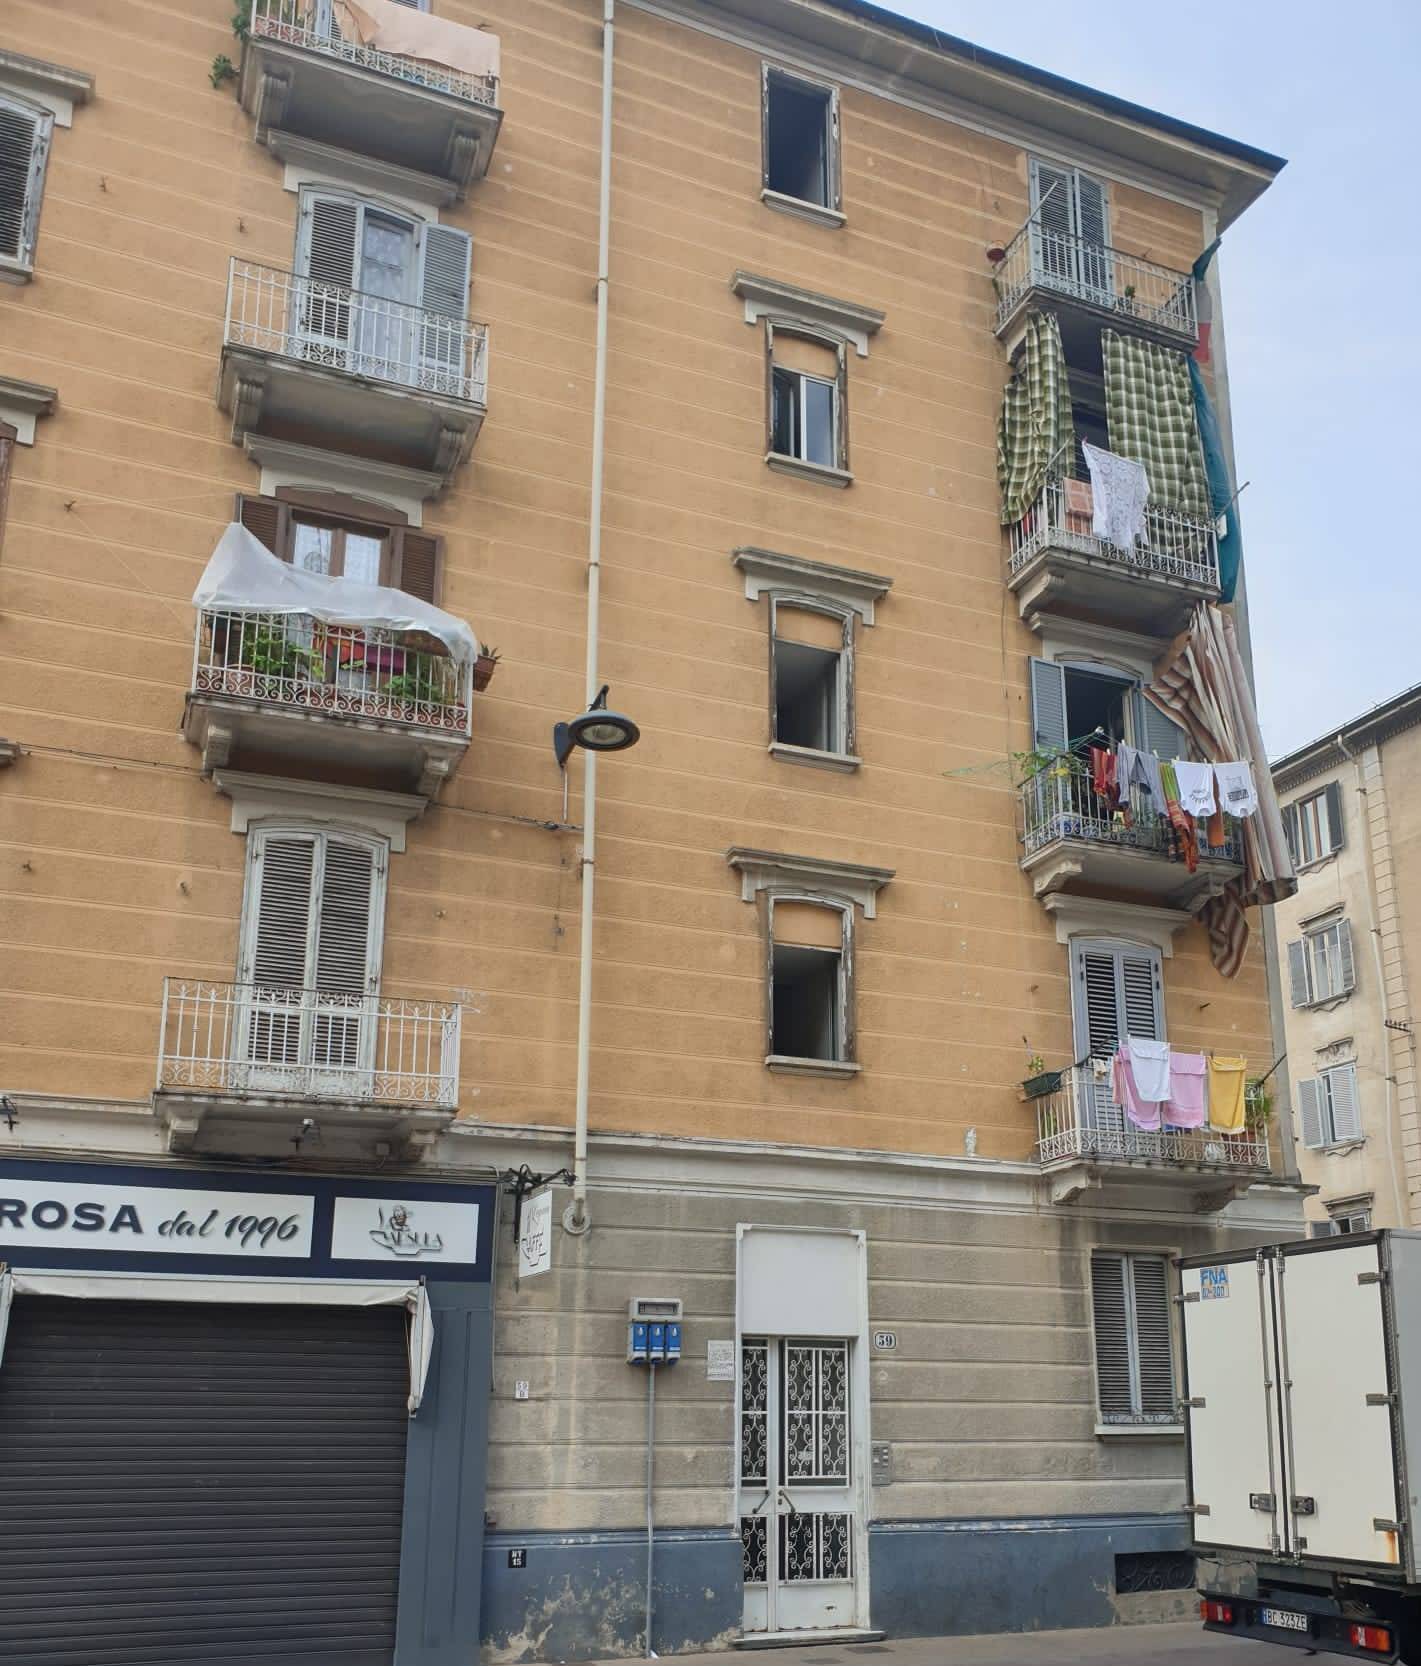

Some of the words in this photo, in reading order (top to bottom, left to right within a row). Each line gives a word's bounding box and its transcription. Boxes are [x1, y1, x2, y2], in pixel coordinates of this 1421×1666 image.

[0, 1198, 143, 1233] ROSA
[158, 1209, 219, 1238] dal
[225, 1214, 299, 1248] 1996
[1200, 1268, 1228, 1286] FNA
[879, 1335, 892, 1347] 59
